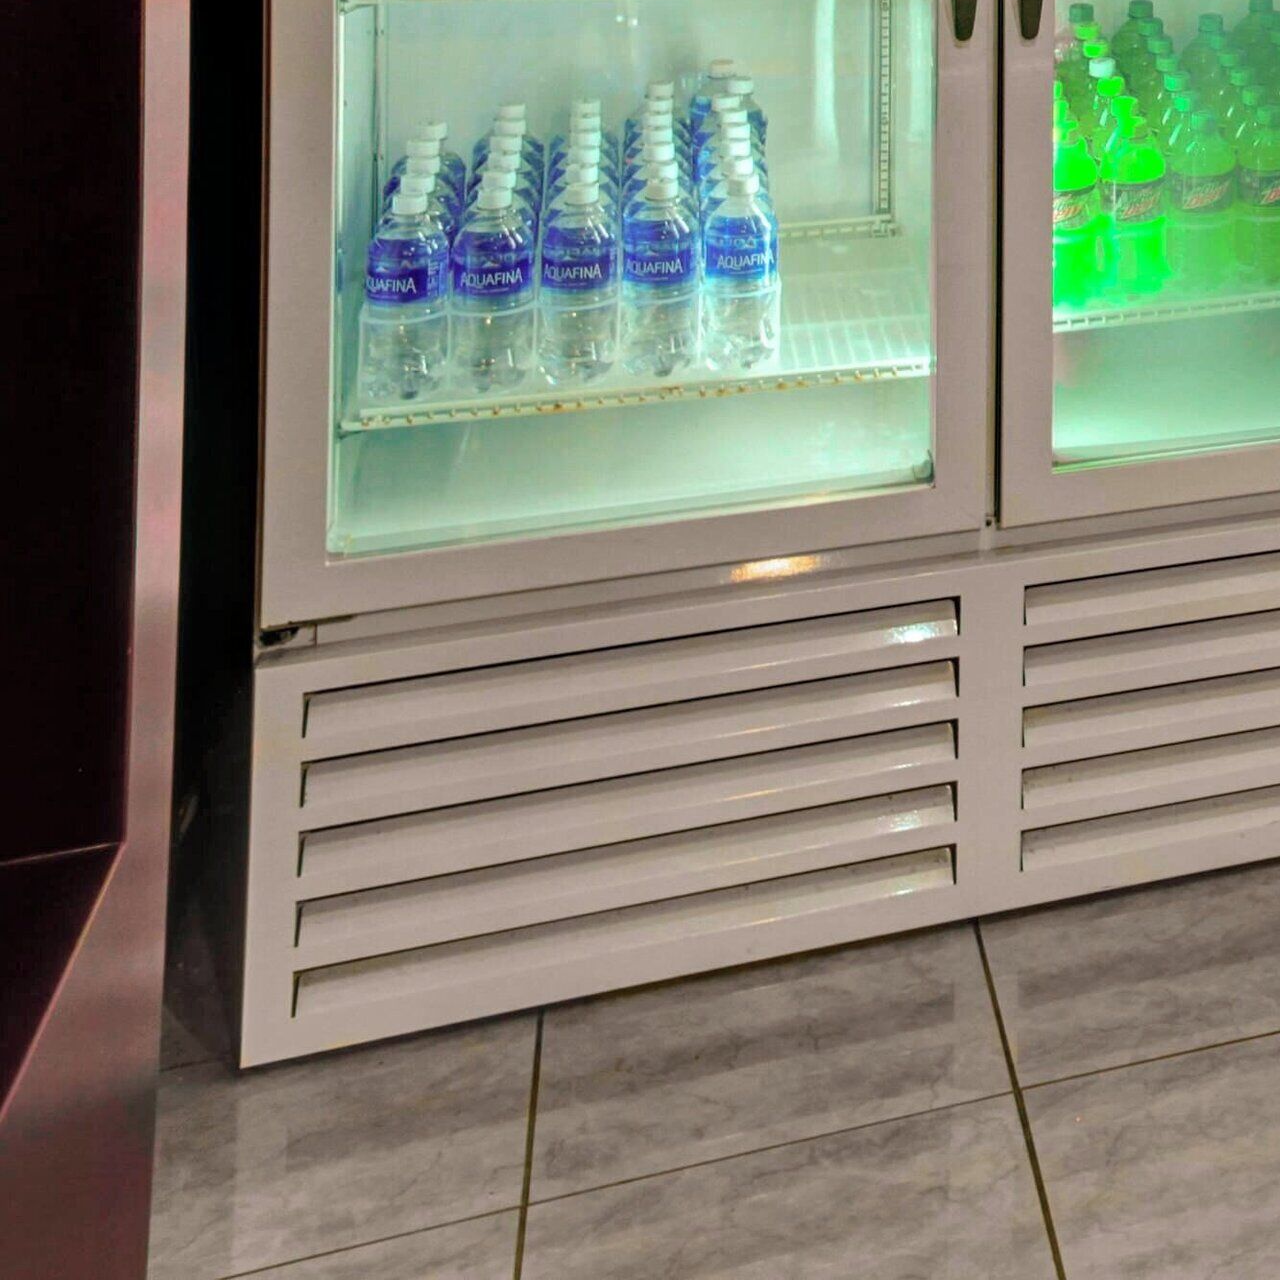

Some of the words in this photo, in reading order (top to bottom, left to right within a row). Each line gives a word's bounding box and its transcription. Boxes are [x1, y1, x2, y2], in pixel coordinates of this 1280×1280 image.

[626, 258, 684, 276] AQUAFINA
[717, 250, 775, 271] AQUAFINA
[461, 267, 523, 288] AQUAFINA
[544, 263, 603, 282] AQUAFINA
[366, 276, 417, 294] QUAFINA
